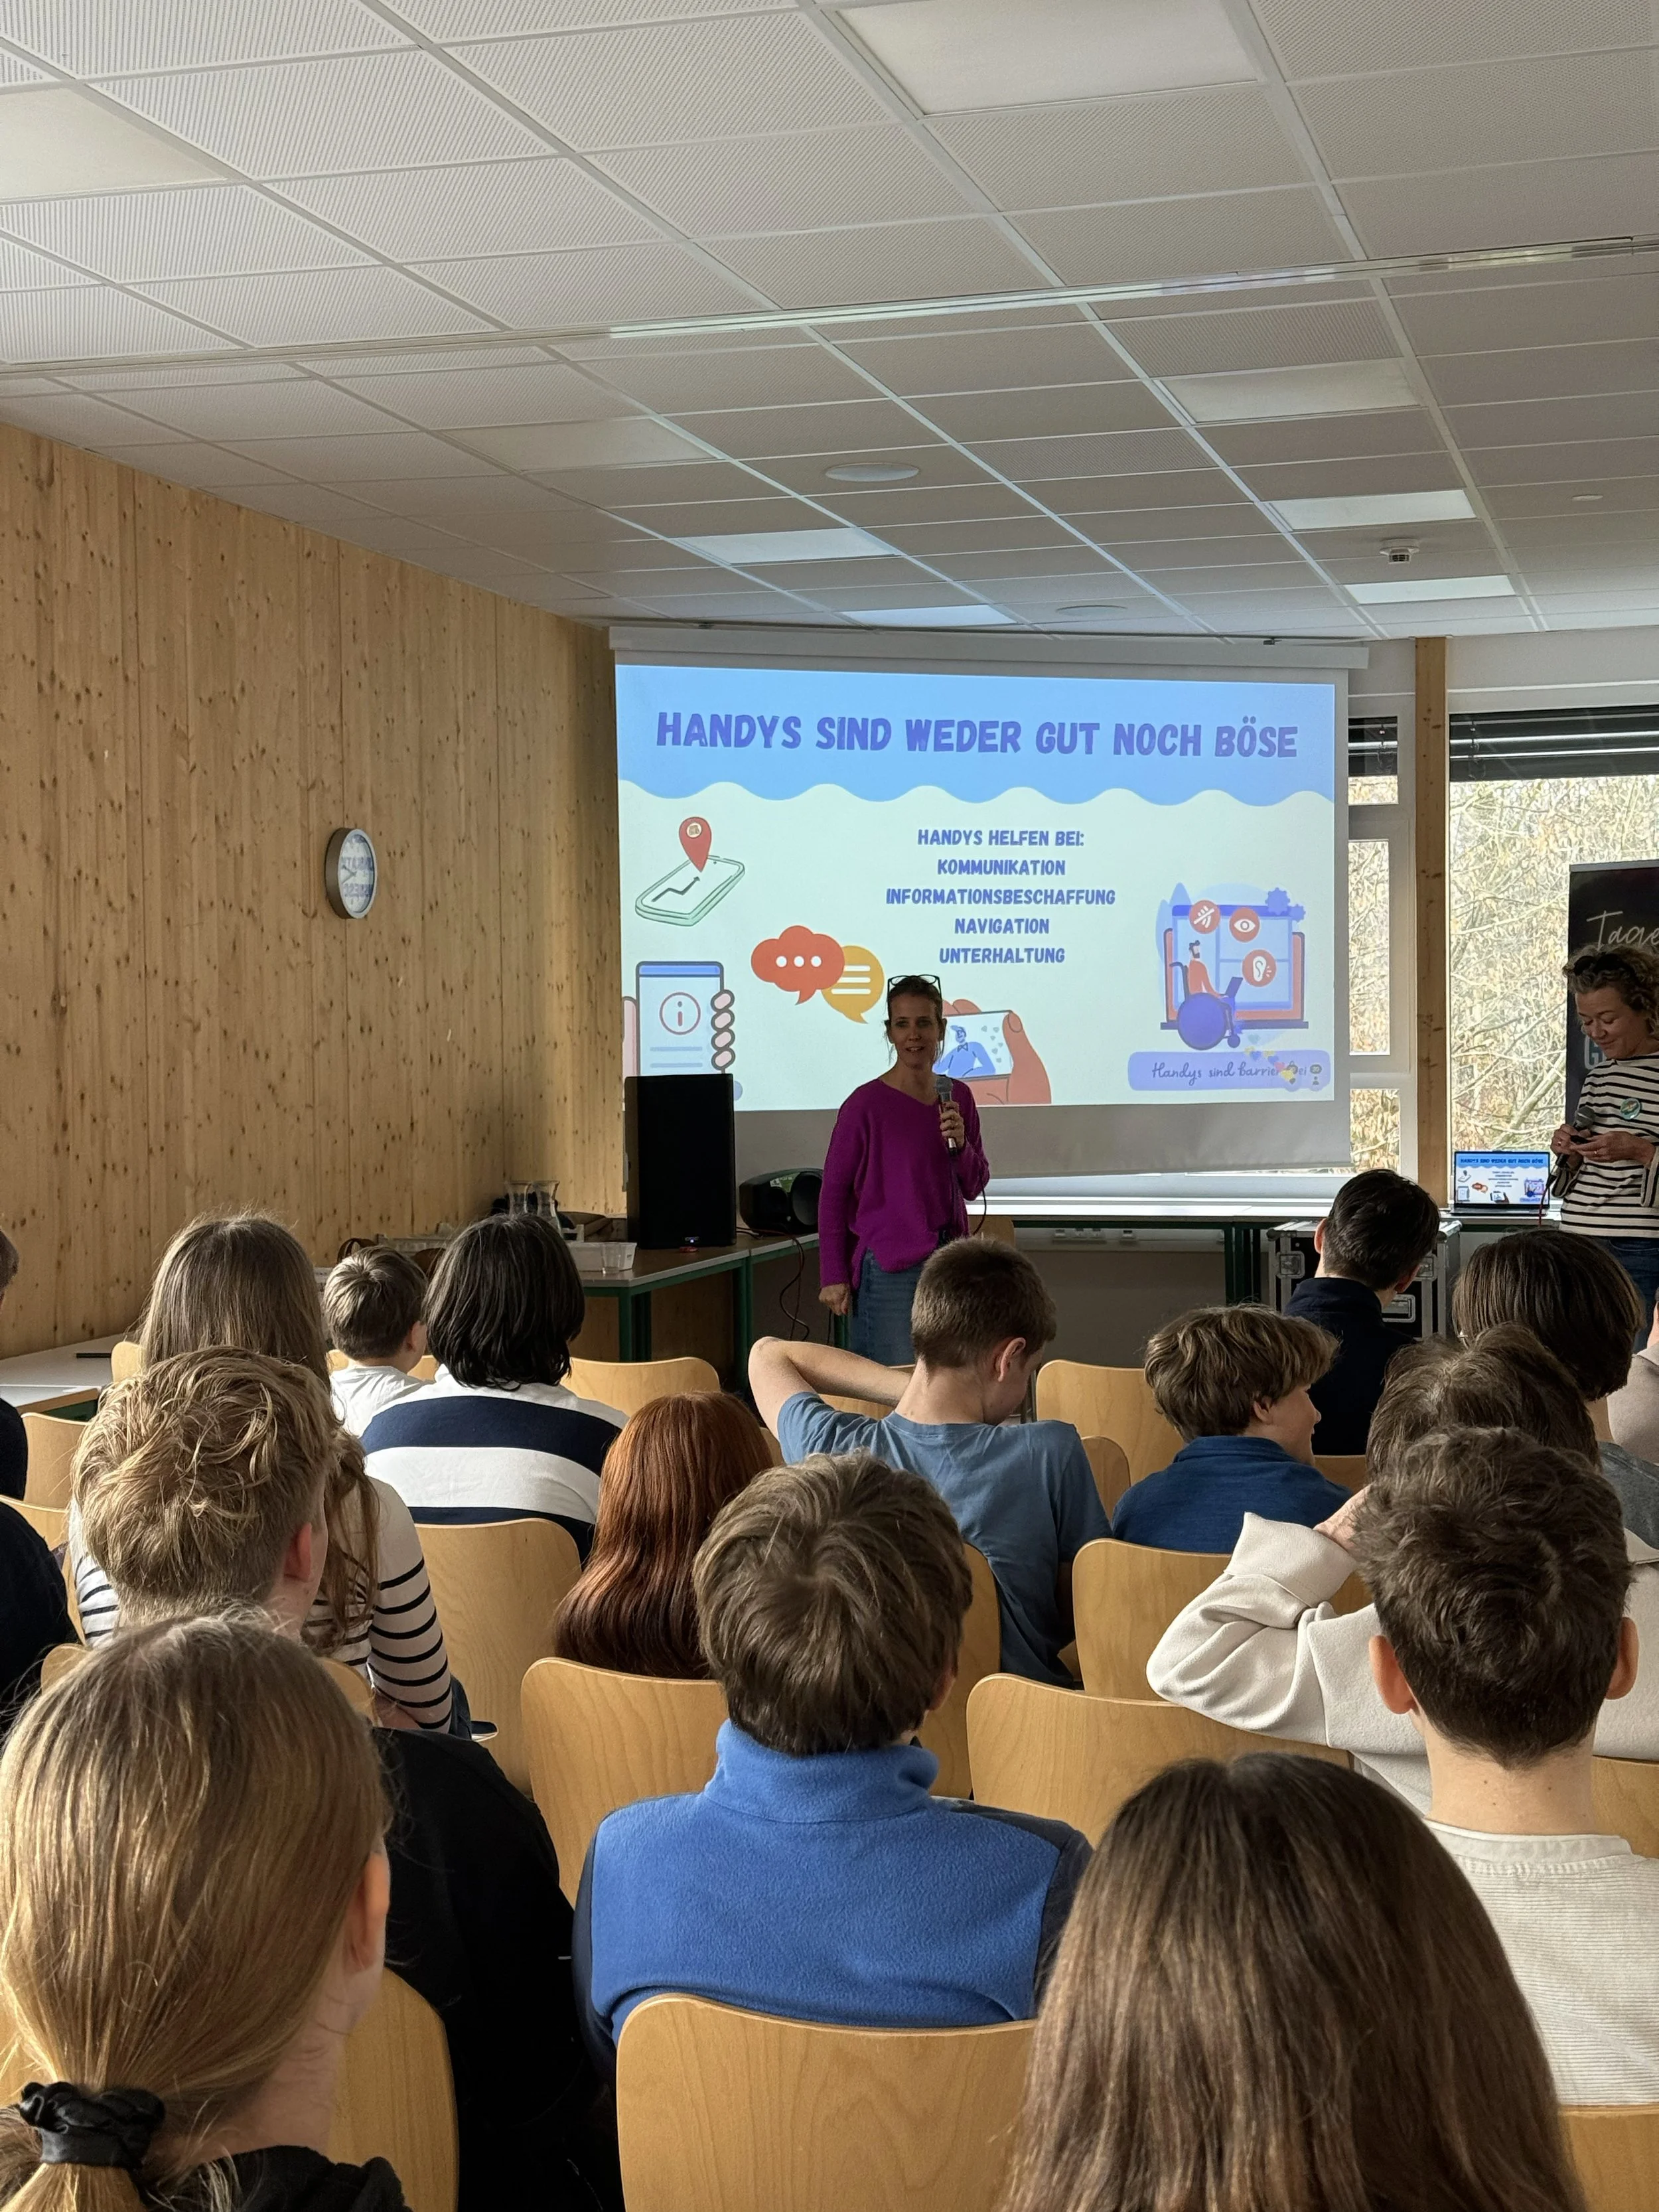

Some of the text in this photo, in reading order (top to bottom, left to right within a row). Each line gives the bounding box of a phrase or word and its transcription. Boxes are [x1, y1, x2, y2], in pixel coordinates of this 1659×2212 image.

[656, 712, 1298, 758] HANDYS SIND WEDER GUT NOCH BÖSE
[917, 830, 1084, 846] HANDYS HELFEN BEI:
[937, 859, 1066, 875] KOMMUNIKATION
[886, 889, 1116, 905] INFORMATIONSBESCHAFFUNG
[954, 919, 1049, 934] NAVIGATION
[939, 948, 1065, 963] UNTERHALTUNG
[1152, 1062, 1202, 1086] Handys
[1209, 1061, 1235, 1078] sind
